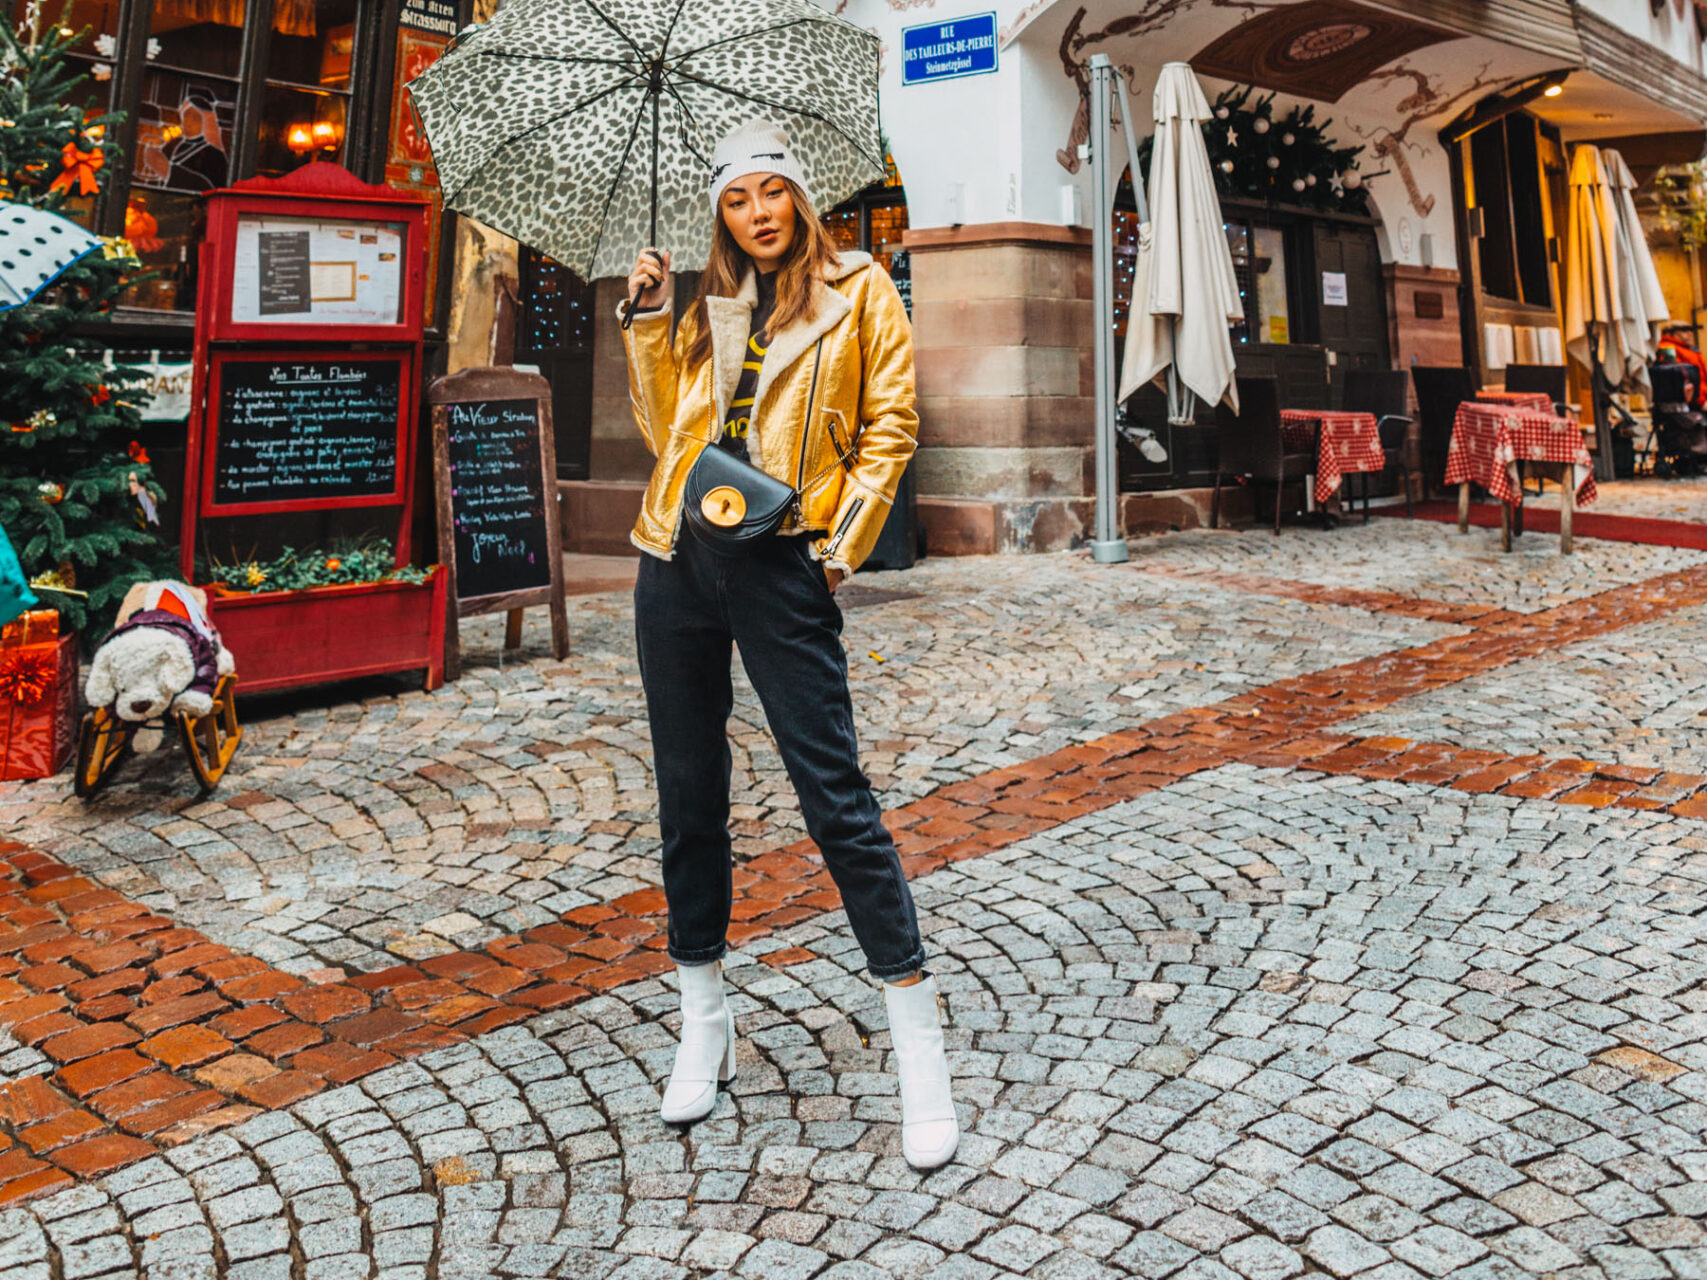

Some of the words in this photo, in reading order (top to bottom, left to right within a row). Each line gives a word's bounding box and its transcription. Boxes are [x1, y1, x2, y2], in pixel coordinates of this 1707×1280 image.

[428, 0, 454, 17] Alten
[940, 24, 955, 39] RUE
[905, 47, 918, 62] DES
[918, 34, 994, 60] TAILLEURS-DE-PIERRE
[269, 366, 288, 381] Nos
